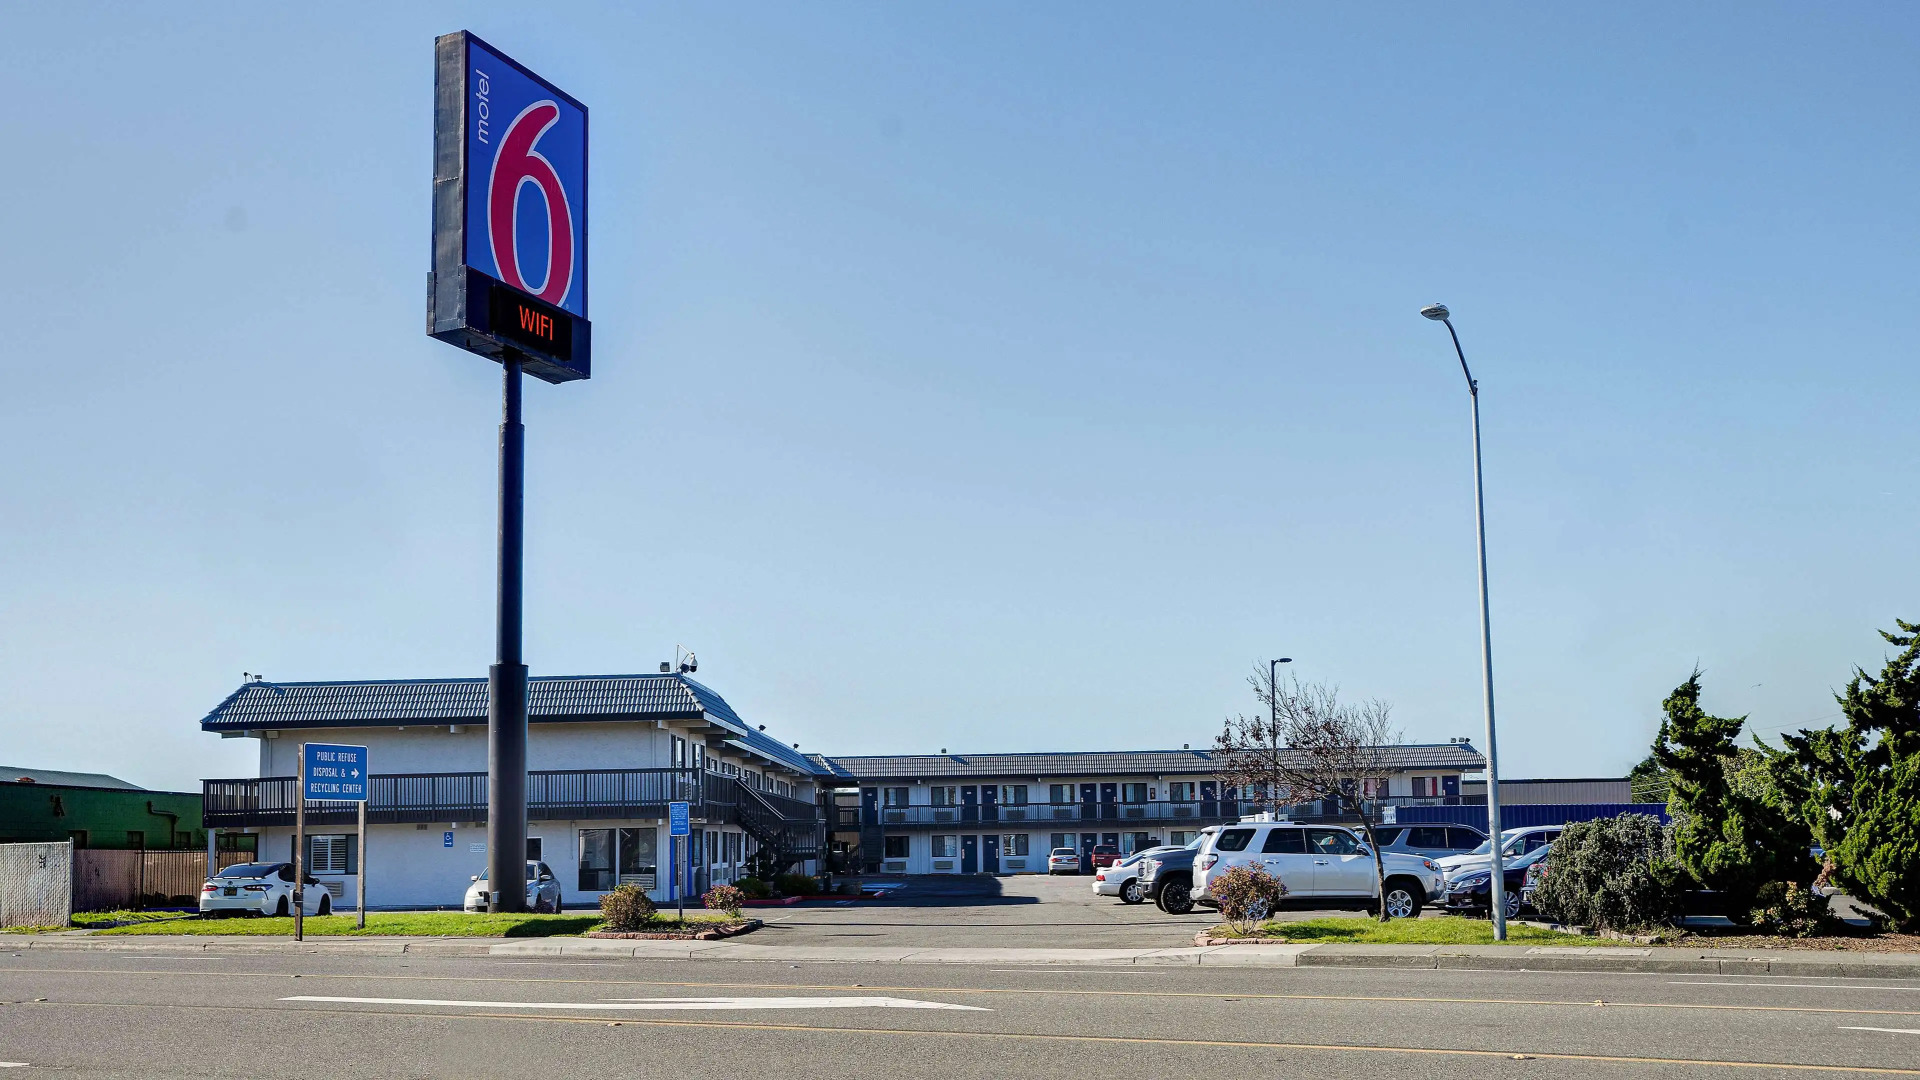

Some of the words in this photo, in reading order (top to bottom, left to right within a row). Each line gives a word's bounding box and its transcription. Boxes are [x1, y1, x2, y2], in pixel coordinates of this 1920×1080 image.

[475, 68, 489, 145] motel
[487, 99, 574, 307] 6
[519, 304, 553, 341] WIFI
[316, 752, 336, 761] PUBLIC
[338, 753, 356, 762] REFUSE
[313, 767, 338, 777] DISPOSAL
[341, 769, 346, 777] &
[311, 783, 339, 793] RECYCLING
[342, 784, 362, 793] CENTER
